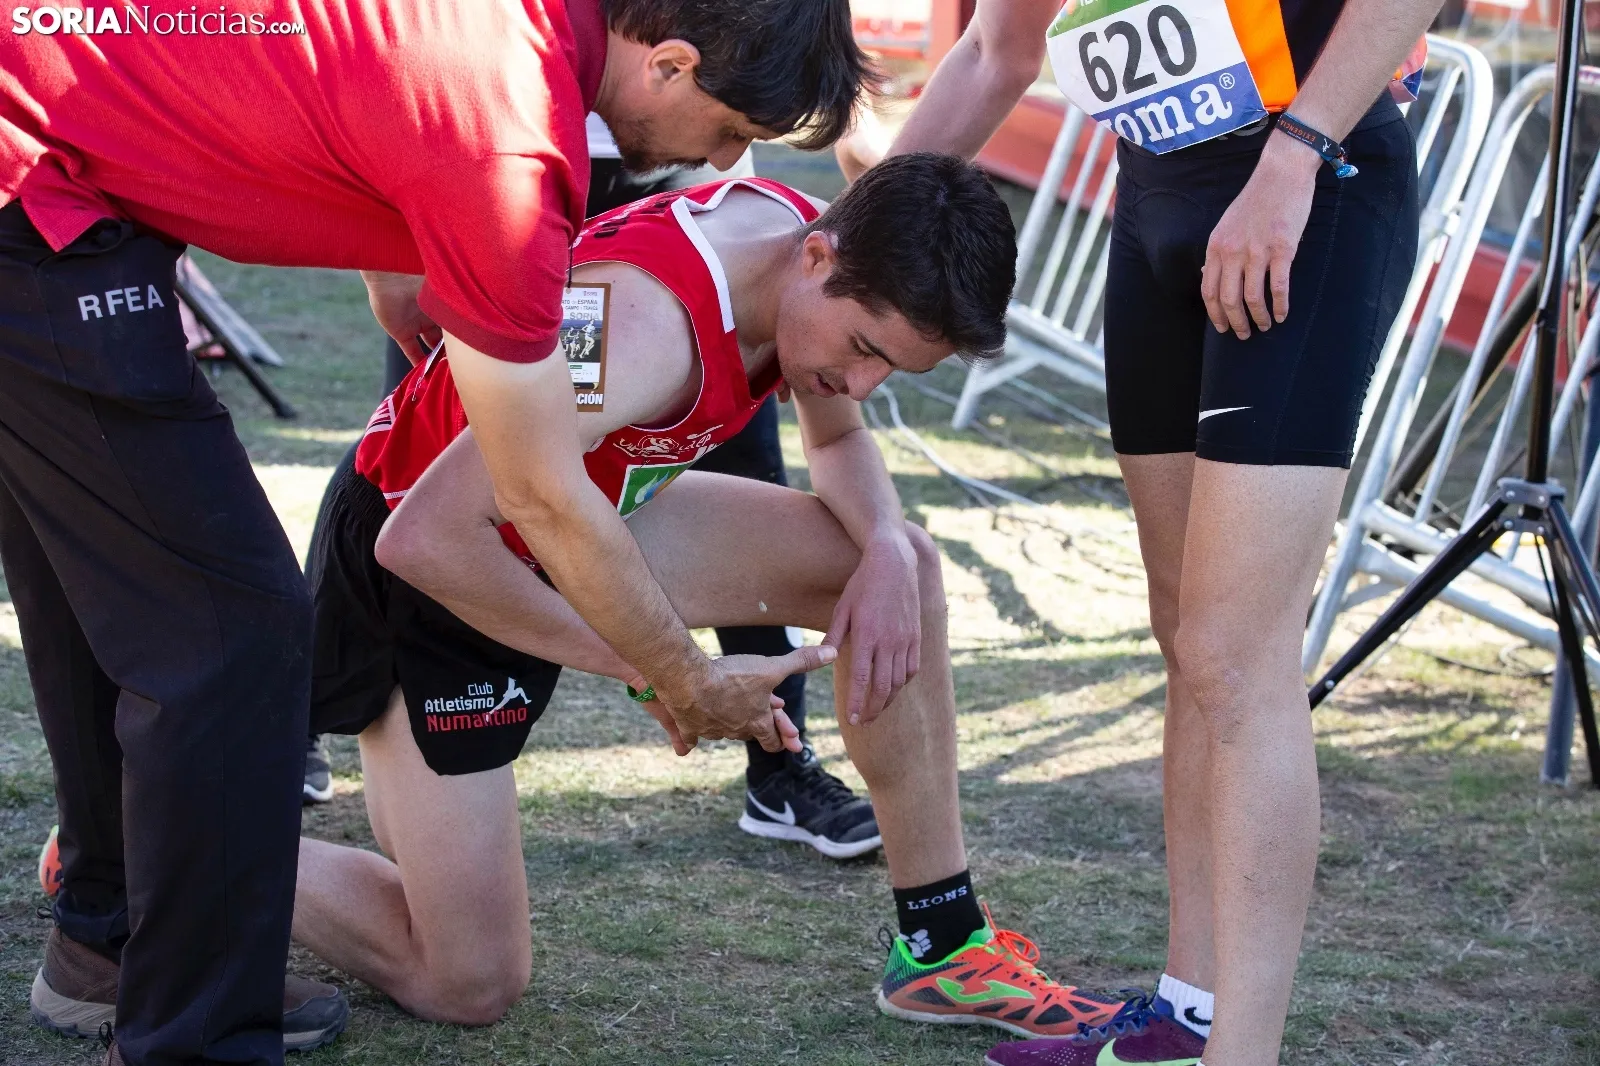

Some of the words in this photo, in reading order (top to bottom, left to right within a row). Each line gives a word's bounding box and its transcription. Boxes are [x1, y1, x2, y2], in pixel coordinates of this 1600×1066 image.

[1078, 4, 1197, 103] 620
[77, 284, 165, 321] RFEA
[569, 311, 600, 320] SORIA
[575, 391, 604, 405] CIÓN
[467, 681, 494, 697] Club
[424, 696, 495, 713] Atletismo
[426, 707, 528, 732] Numantino
[906, 885, 968, 910] LIONS
